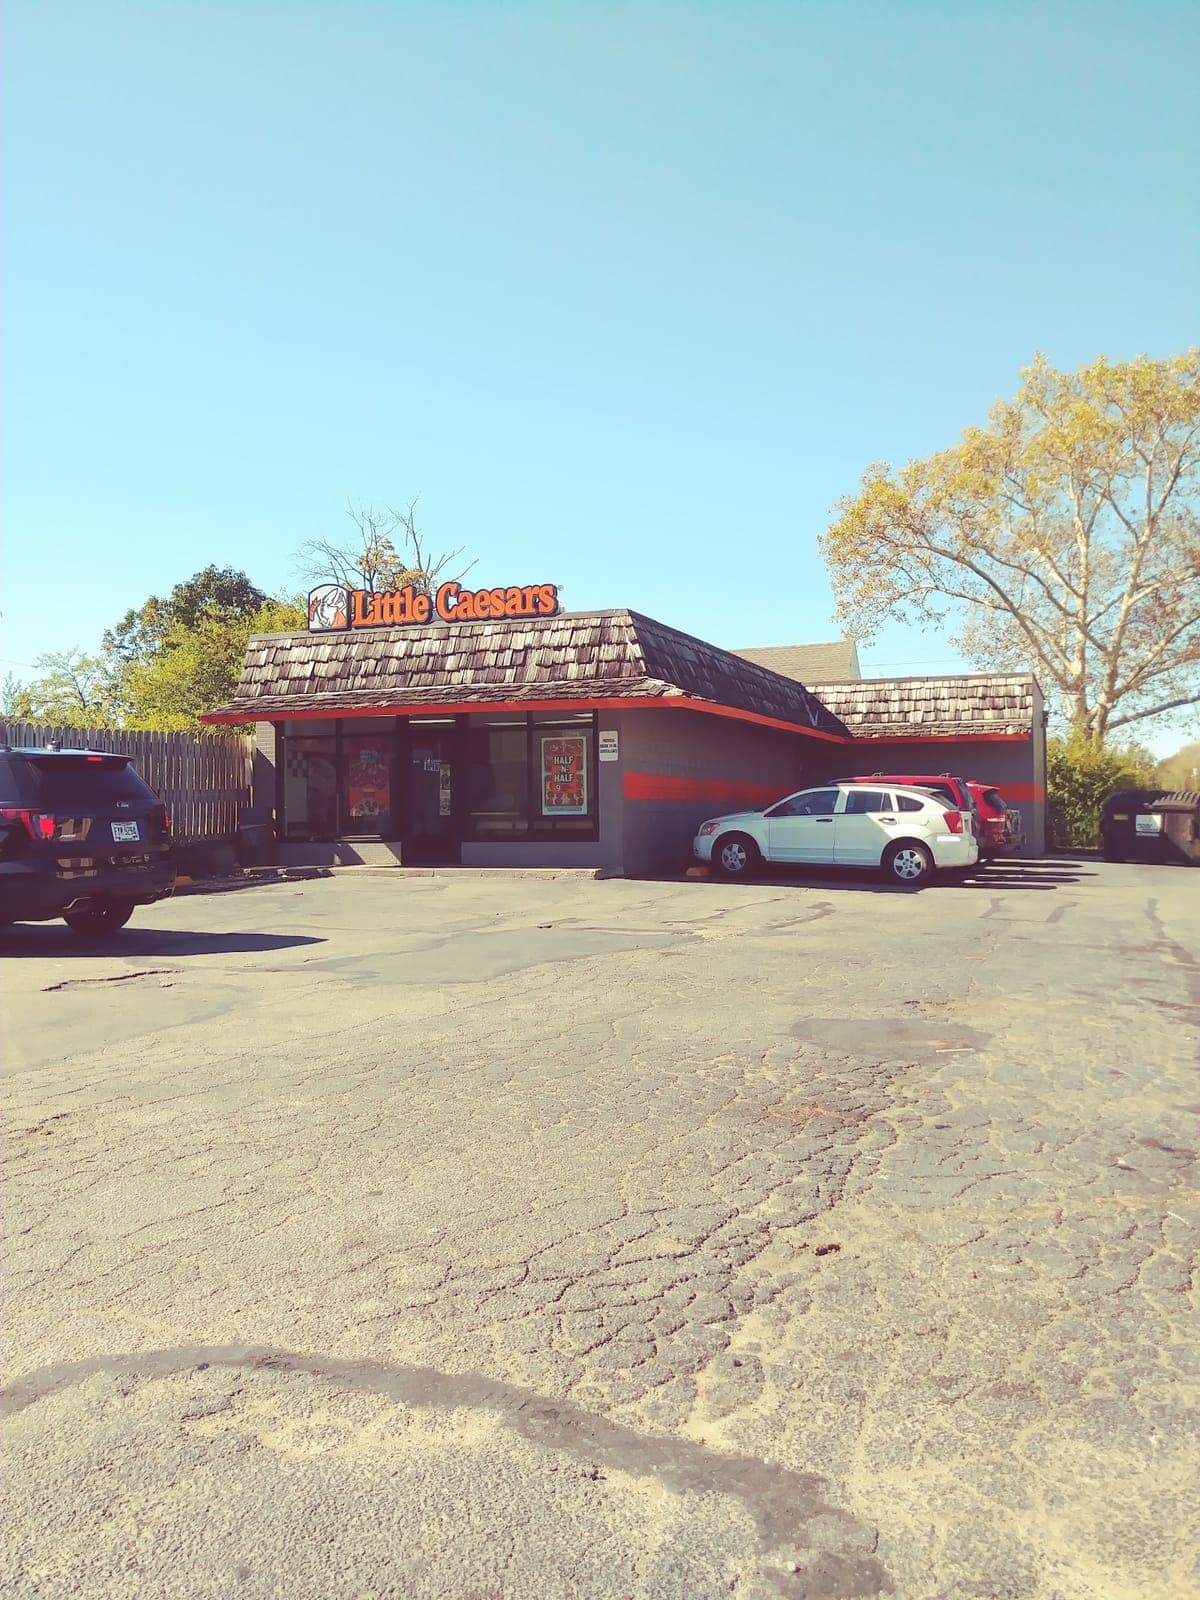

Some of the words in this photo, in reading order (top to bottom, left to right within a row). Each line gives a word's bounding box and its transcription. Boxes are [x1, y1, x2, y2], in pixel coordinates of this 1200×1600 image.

[351, 586, 432, 628] Little
[436, 582, 558, 622] Caesars
[554, 756, 574, 765] HALF
[554, 774, 574, 783] HALF
